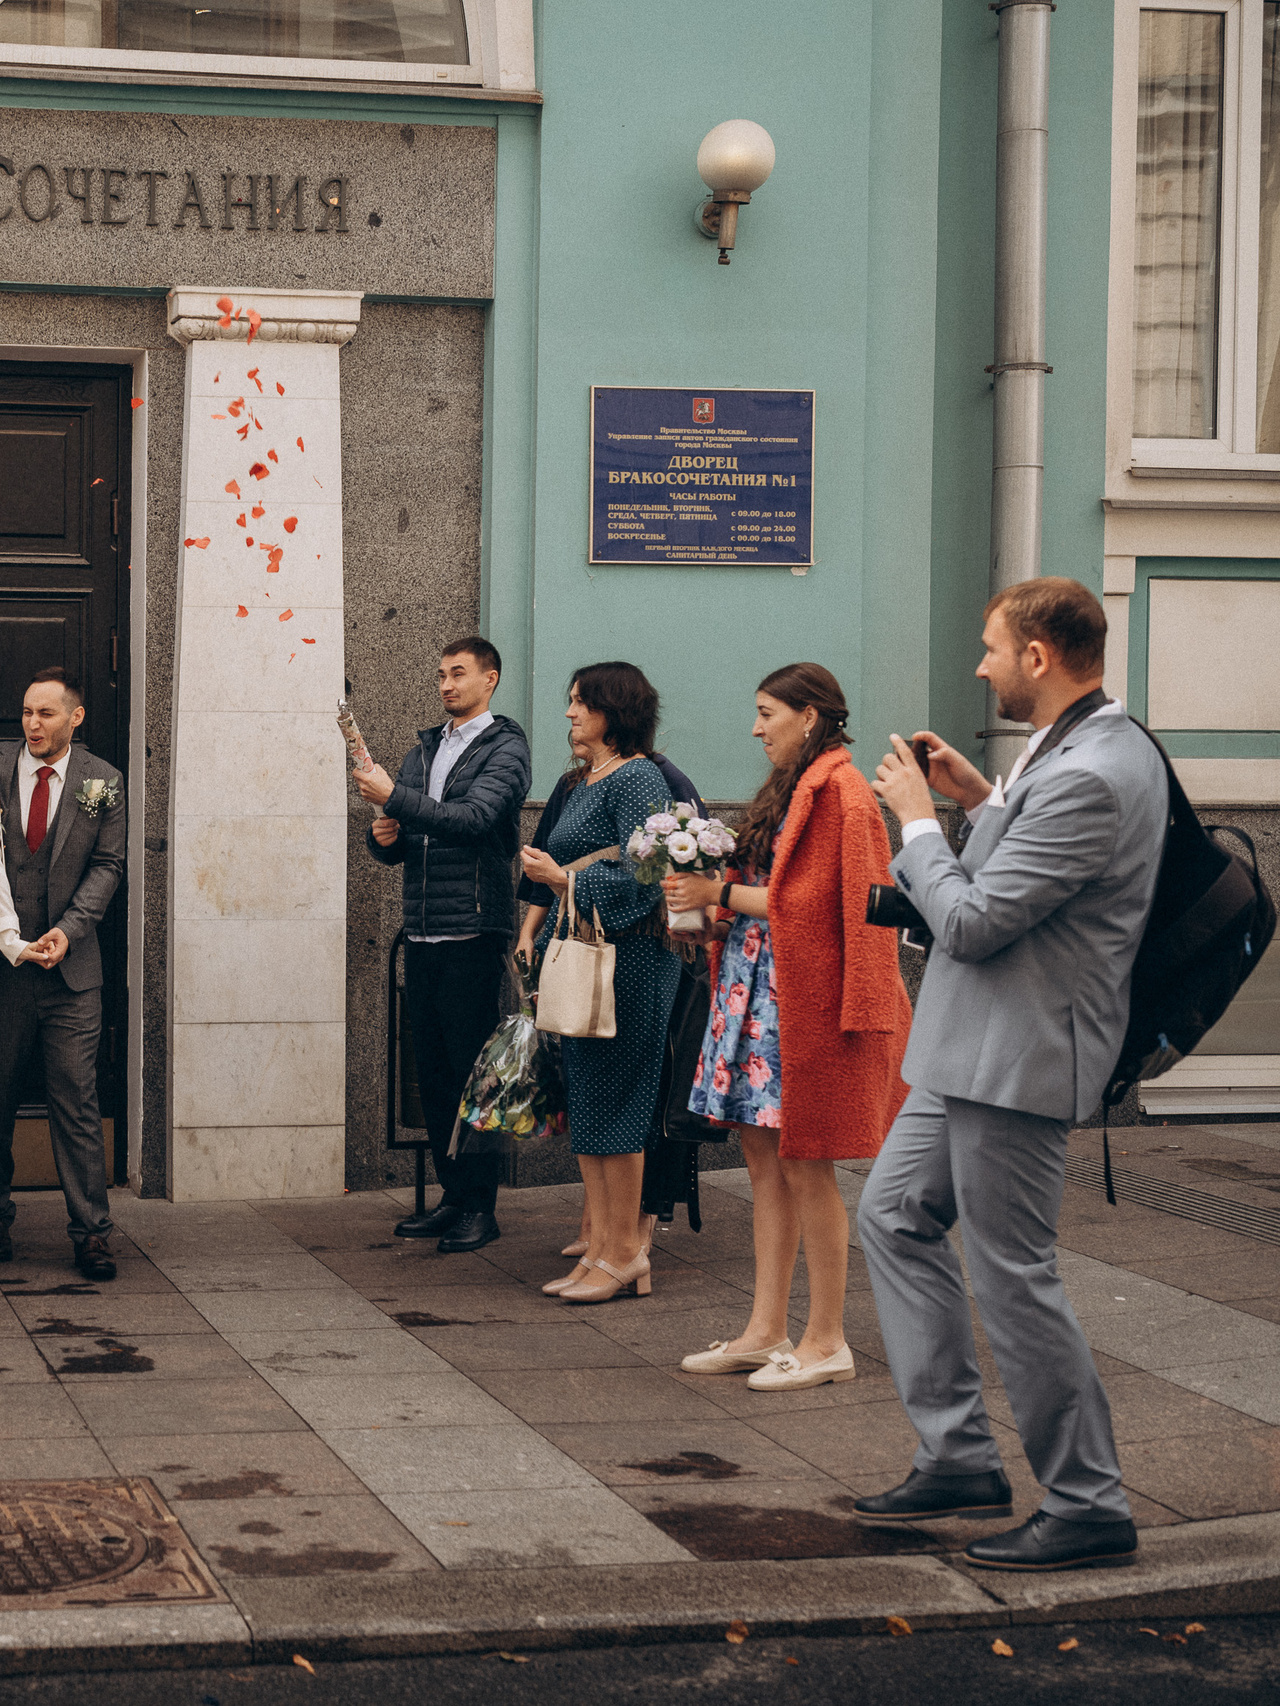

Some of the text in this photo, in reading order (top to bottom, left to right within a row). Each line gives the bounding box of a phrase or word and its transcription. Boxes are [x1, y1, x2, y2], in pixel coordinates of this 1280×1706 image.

[660, 427, 716, 435] Правительство
[608, 432, 652, 440] Управление
[667, 455, 739, 472] ДВОРЕЦ
[608, 471, 767, 487] БРАКОСОЧЕТАНИЯ
[669, 492, 736, 501] ЧАСЫ РАБОТЫ
[608, 503, 713, 512] ПОНЕДЕЛЬНИК, ВТОРНИК,
[608, 512, 718, 521] СРЕДА, ЧЕТВЕРГ, ПЯТНИЦА
[608, 522, 645, 530] СУББОТА
